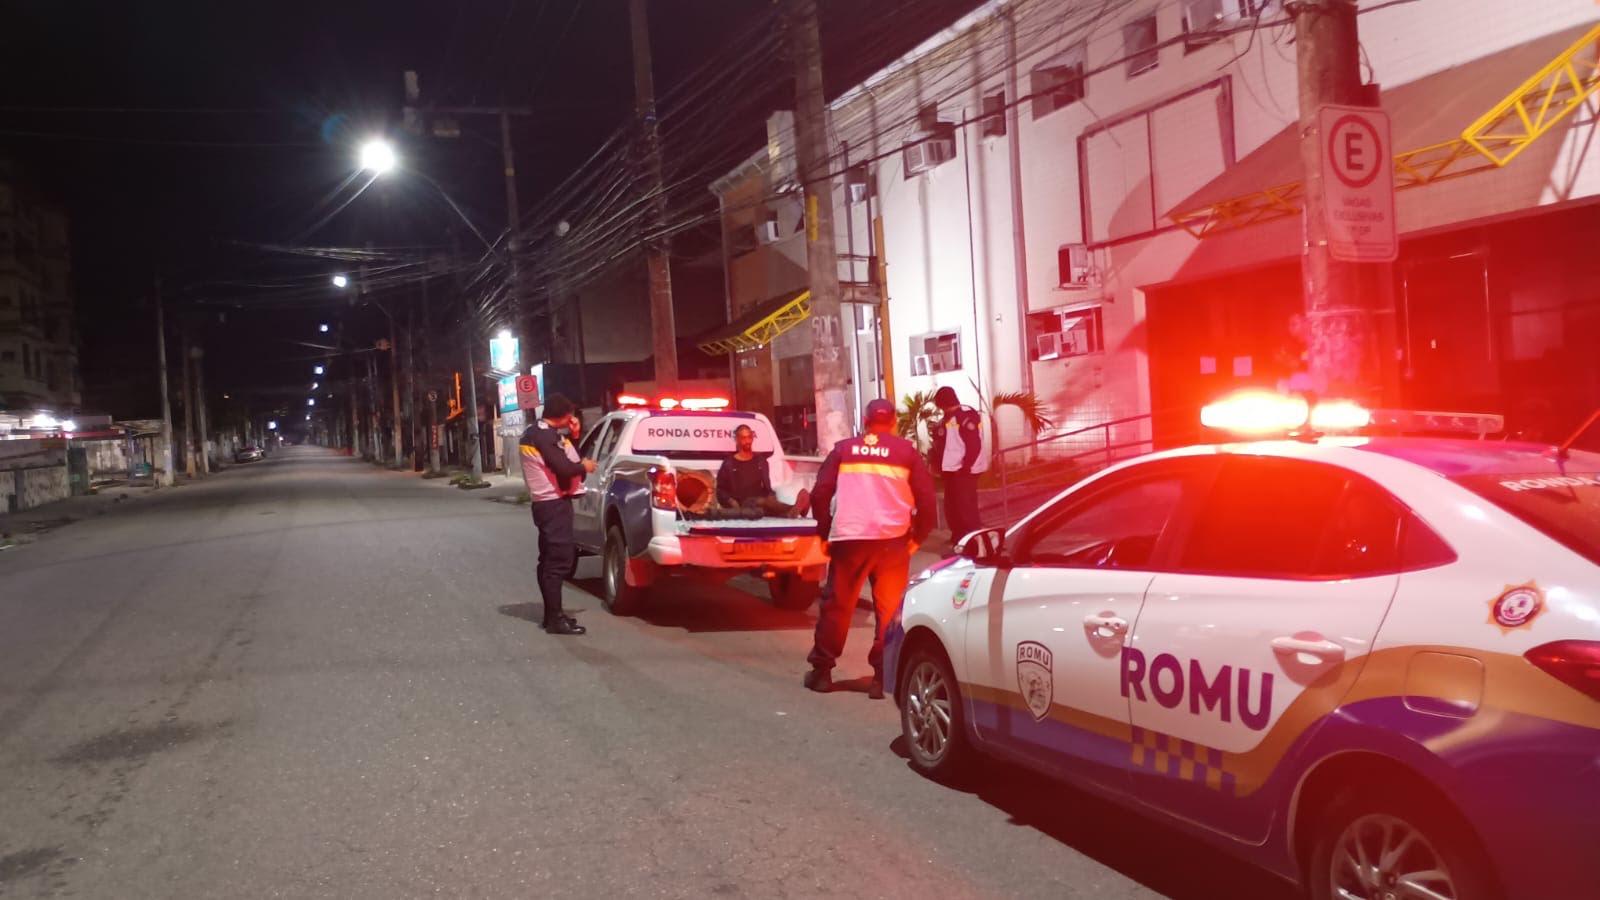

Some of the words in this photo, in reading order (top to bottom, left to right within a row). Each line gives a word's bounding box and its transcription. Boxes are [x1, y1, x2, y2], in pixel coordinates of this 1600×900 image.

[1345, 132, 1364, 170] E
[647, 427, 691, 439] RONDA
[851, 446, 889, 457] ROMU
[1019, 646, 1050, 666] ROMU
[1120, 646, 1275, 732] ROMU
